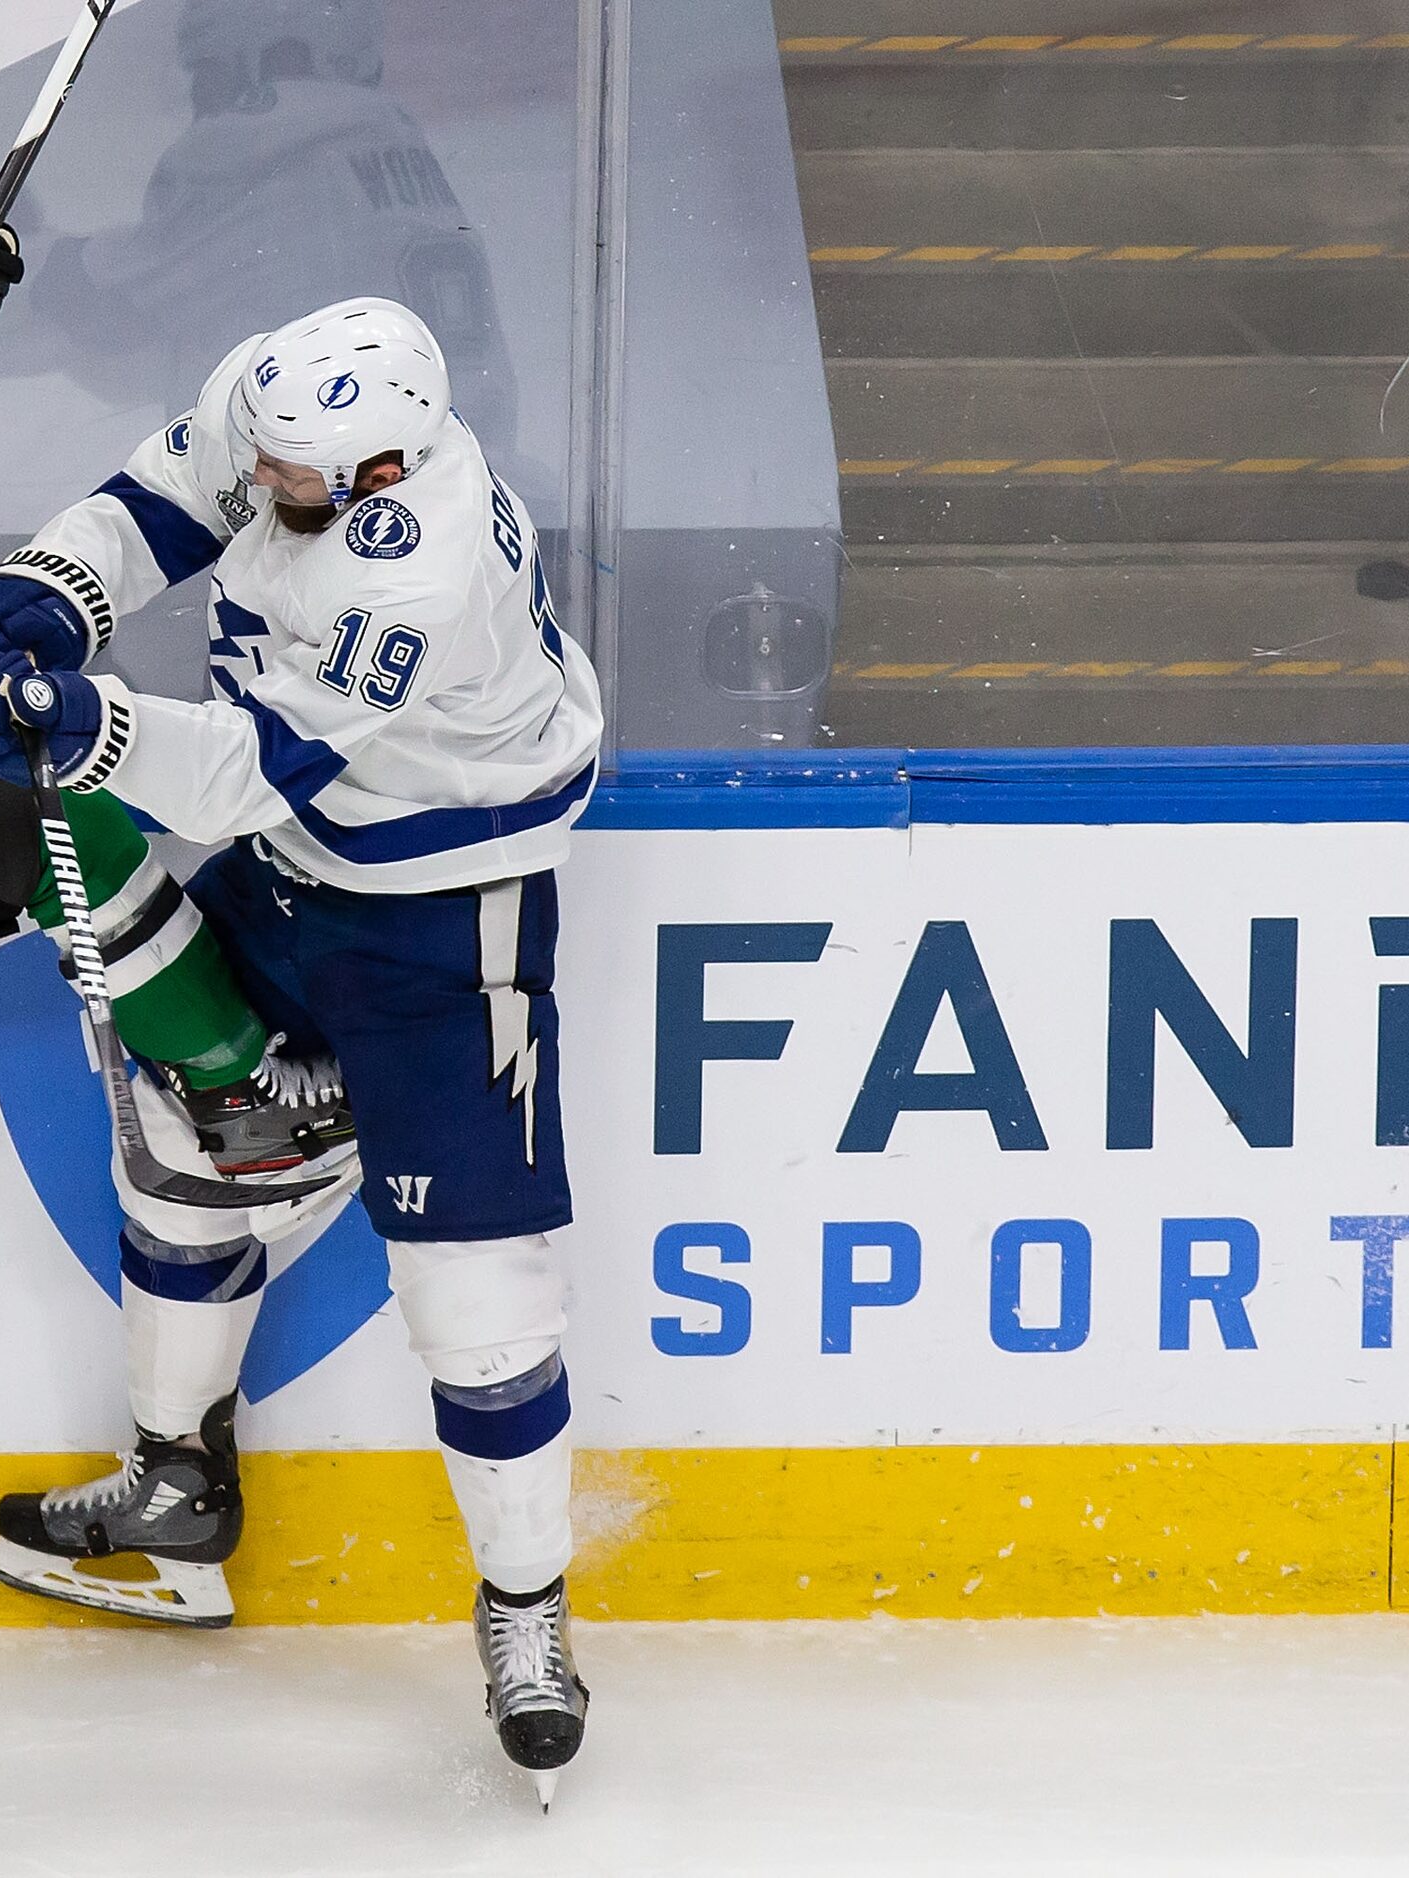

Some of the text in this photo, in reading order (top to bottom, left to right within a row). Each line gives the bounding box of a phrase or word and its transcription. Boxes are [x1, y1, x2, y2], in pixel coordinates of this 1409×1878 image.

[348, 500, 418, 552] TAMPA BAY LIGHTNING
[489, 468, 524, 564] GO
[317, 607, 428, 713] 19
[653, 917, 1409, 1155] FAN
[650, 1215, 1409, 1357] SPORT
